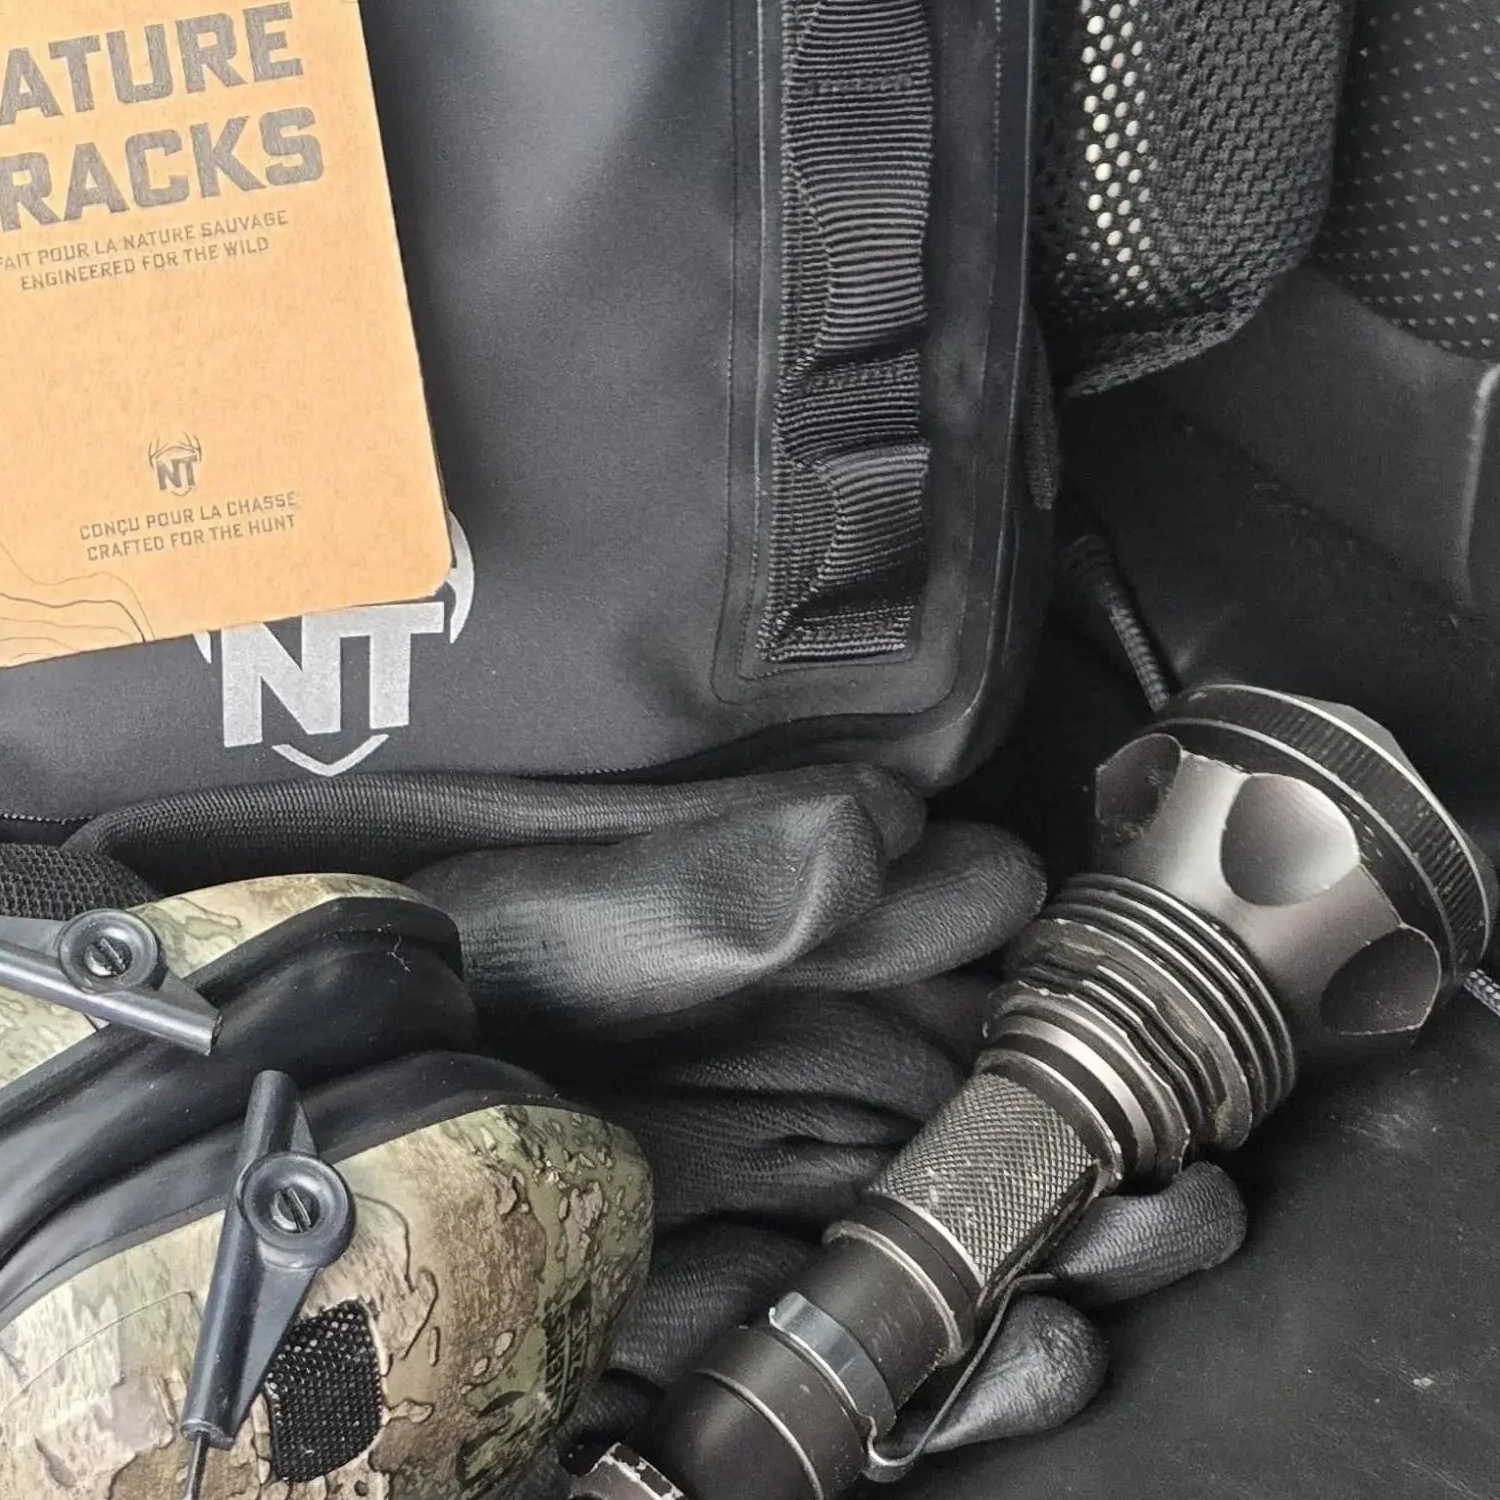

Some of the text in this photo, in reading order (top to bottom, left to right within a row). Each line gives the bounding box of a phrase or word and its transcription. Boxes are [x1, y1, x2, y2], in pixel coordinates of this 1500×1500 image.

[20, 236, 270, 291] ENGINEERED FOR THE WILD
[38, 242, 90, 265] POUR
[94, 238, 117, 256] LA
[123, 225, 195, 250] NATURE
[201, 210, 289, 237] SAUVAGE
[155, 453, 198, 490] NT
[79, 490, 299, 541] CONÇU POUR LA CHASSE
[87, 514, 297, 561] CRAFTED FOR THE HUNT
[220, 601, 445, 748] NT
